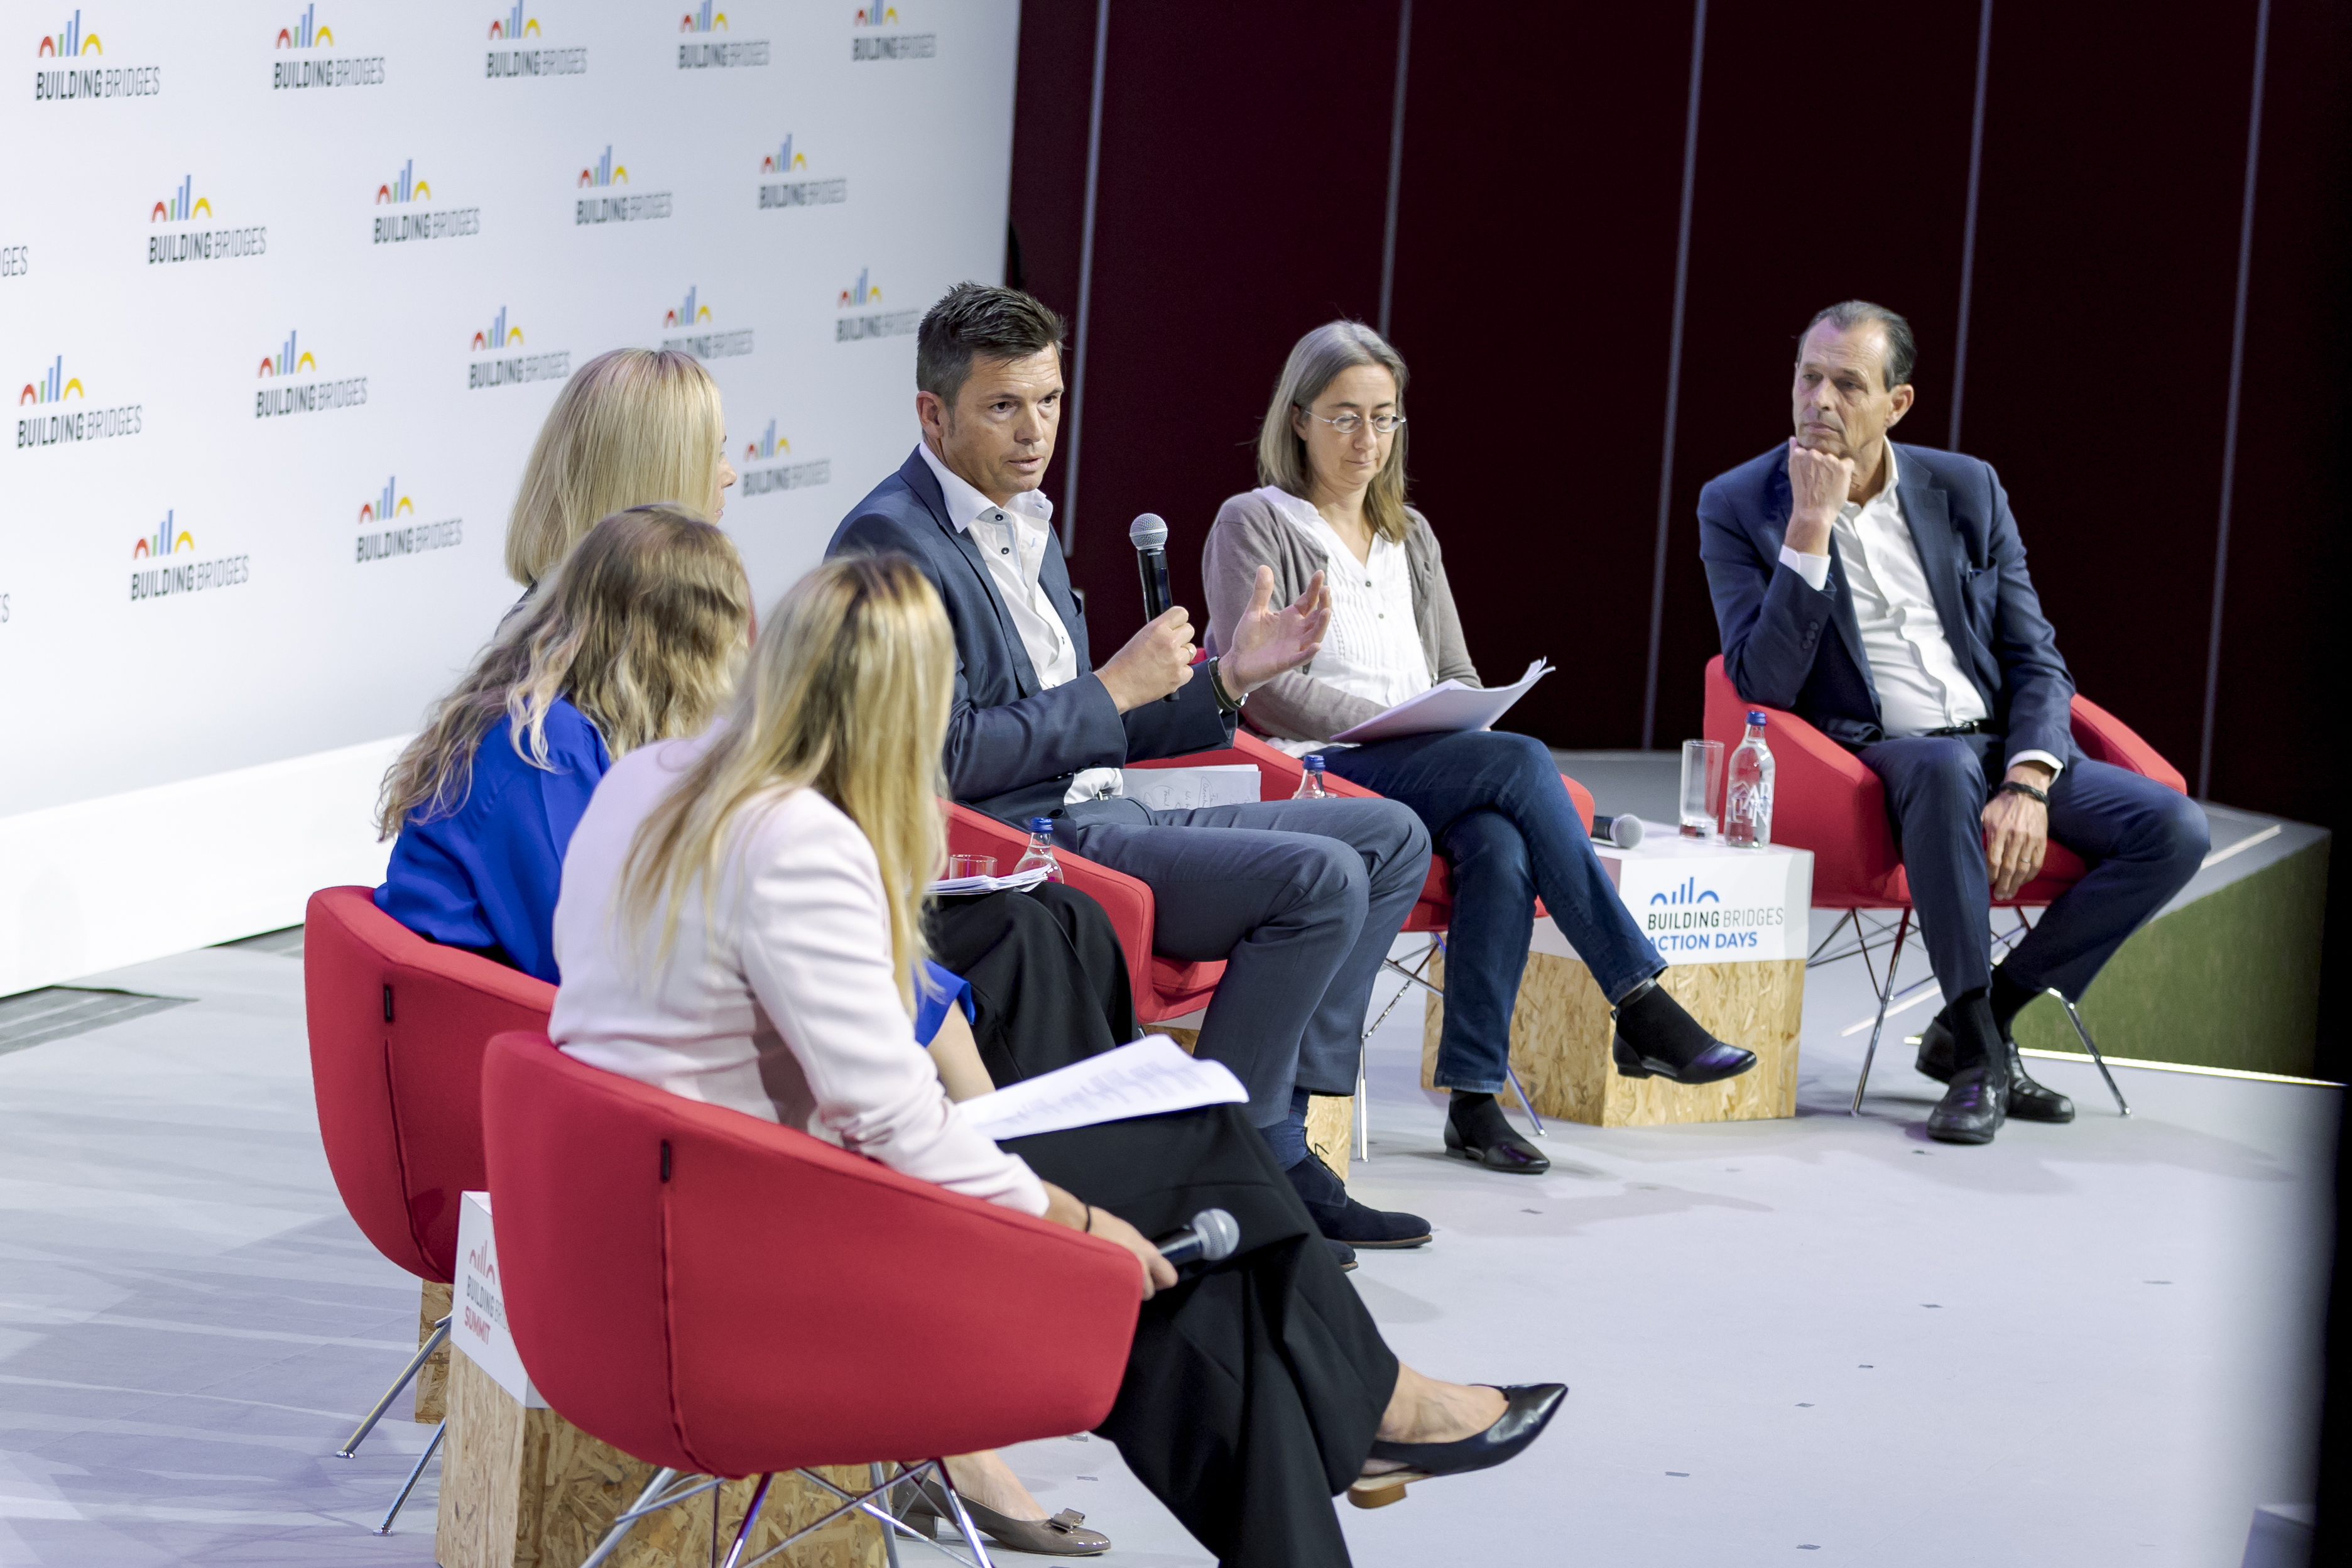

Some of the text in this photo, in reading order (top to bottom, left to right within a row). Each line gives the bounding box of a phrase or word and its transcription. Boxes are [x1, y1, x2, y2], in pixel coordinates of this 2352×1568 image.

[273, 56, 385, 90] BUILDING BRIDGES
[486, 47, 589, 79] BUILDING BRIDGES
[678, 43, 726, 69] BUILDING
[36, 66, 160, 101] BUILDING BRIDGES
[374, 207, 479, 244] BUILDING BRIDGES
[575, 197, 628, 225] BUILDING
[148, 226, 267, 265] BUILDING BRIDGES
[469, 357, 523, 390] BUILDING
[256, 376, 368, 419] BUILDING BRIDGES
[18, 405, 143, 449] BUILDING BRIDGES
[357, 518, 463, 564] BUILDING BRIDGES
[131, 555, 250, 602] BUILDING BRIDGES
[1648, 908, 1783, 930] BUILDING BRIDGES
[1648, 932, 1758, 952] ACTION DAYS
[467, 1274, 495, 1318] BUILDING
[465, 1305, 491, 1346] SUMMIT
